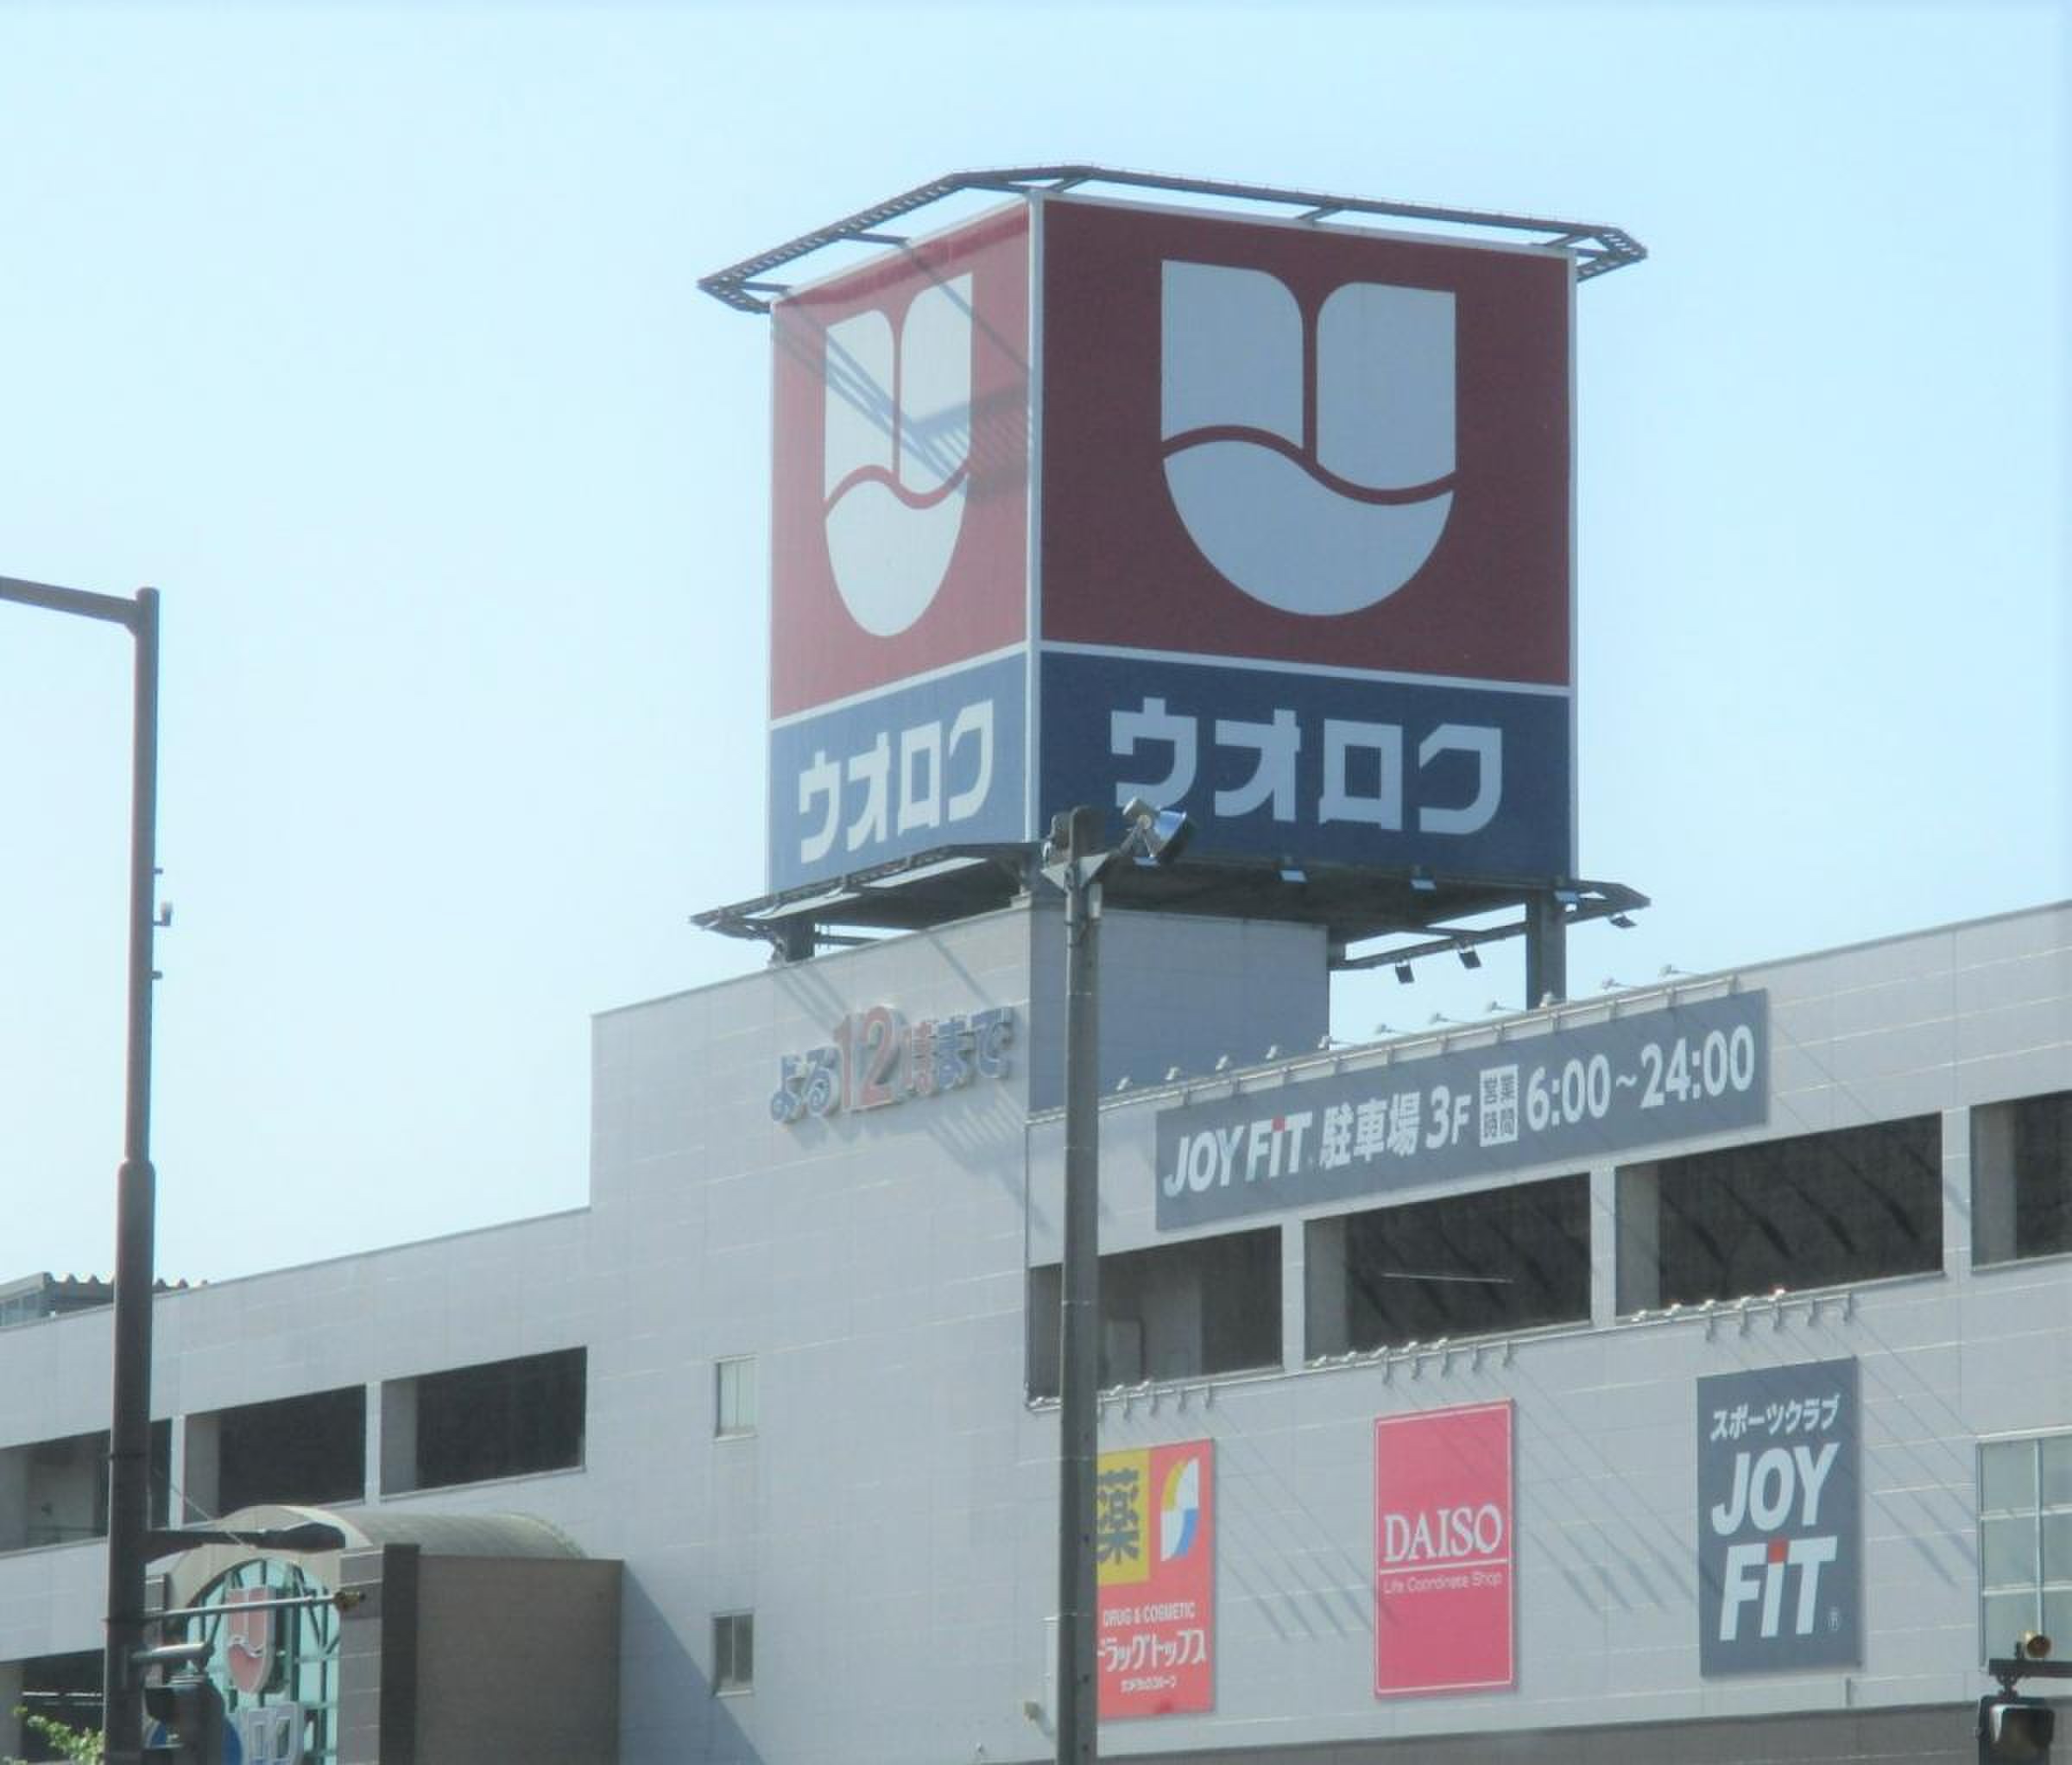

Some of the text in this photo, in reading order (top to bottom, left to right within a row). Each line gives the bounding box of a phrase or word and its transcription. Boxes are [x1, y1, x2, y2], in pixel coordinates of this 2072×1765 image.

[799, 699, 994, 864] ウオロク
[1110, 696, 1503, 835] ウオロク
[1164, 1125, 1245, 1198] JOY
[1319, 1091, 1421, 1170] 駐車場
[1425, 1085, 1472, 1149] 3F
[1709, 1393, 1841, 1441] スポーツクラブ
[1383, 1504, 1503, 1562] DAISO
[1711, 1442, 1841, 1536] JOY
[1472, 1571, 1502, 1589] Shop
